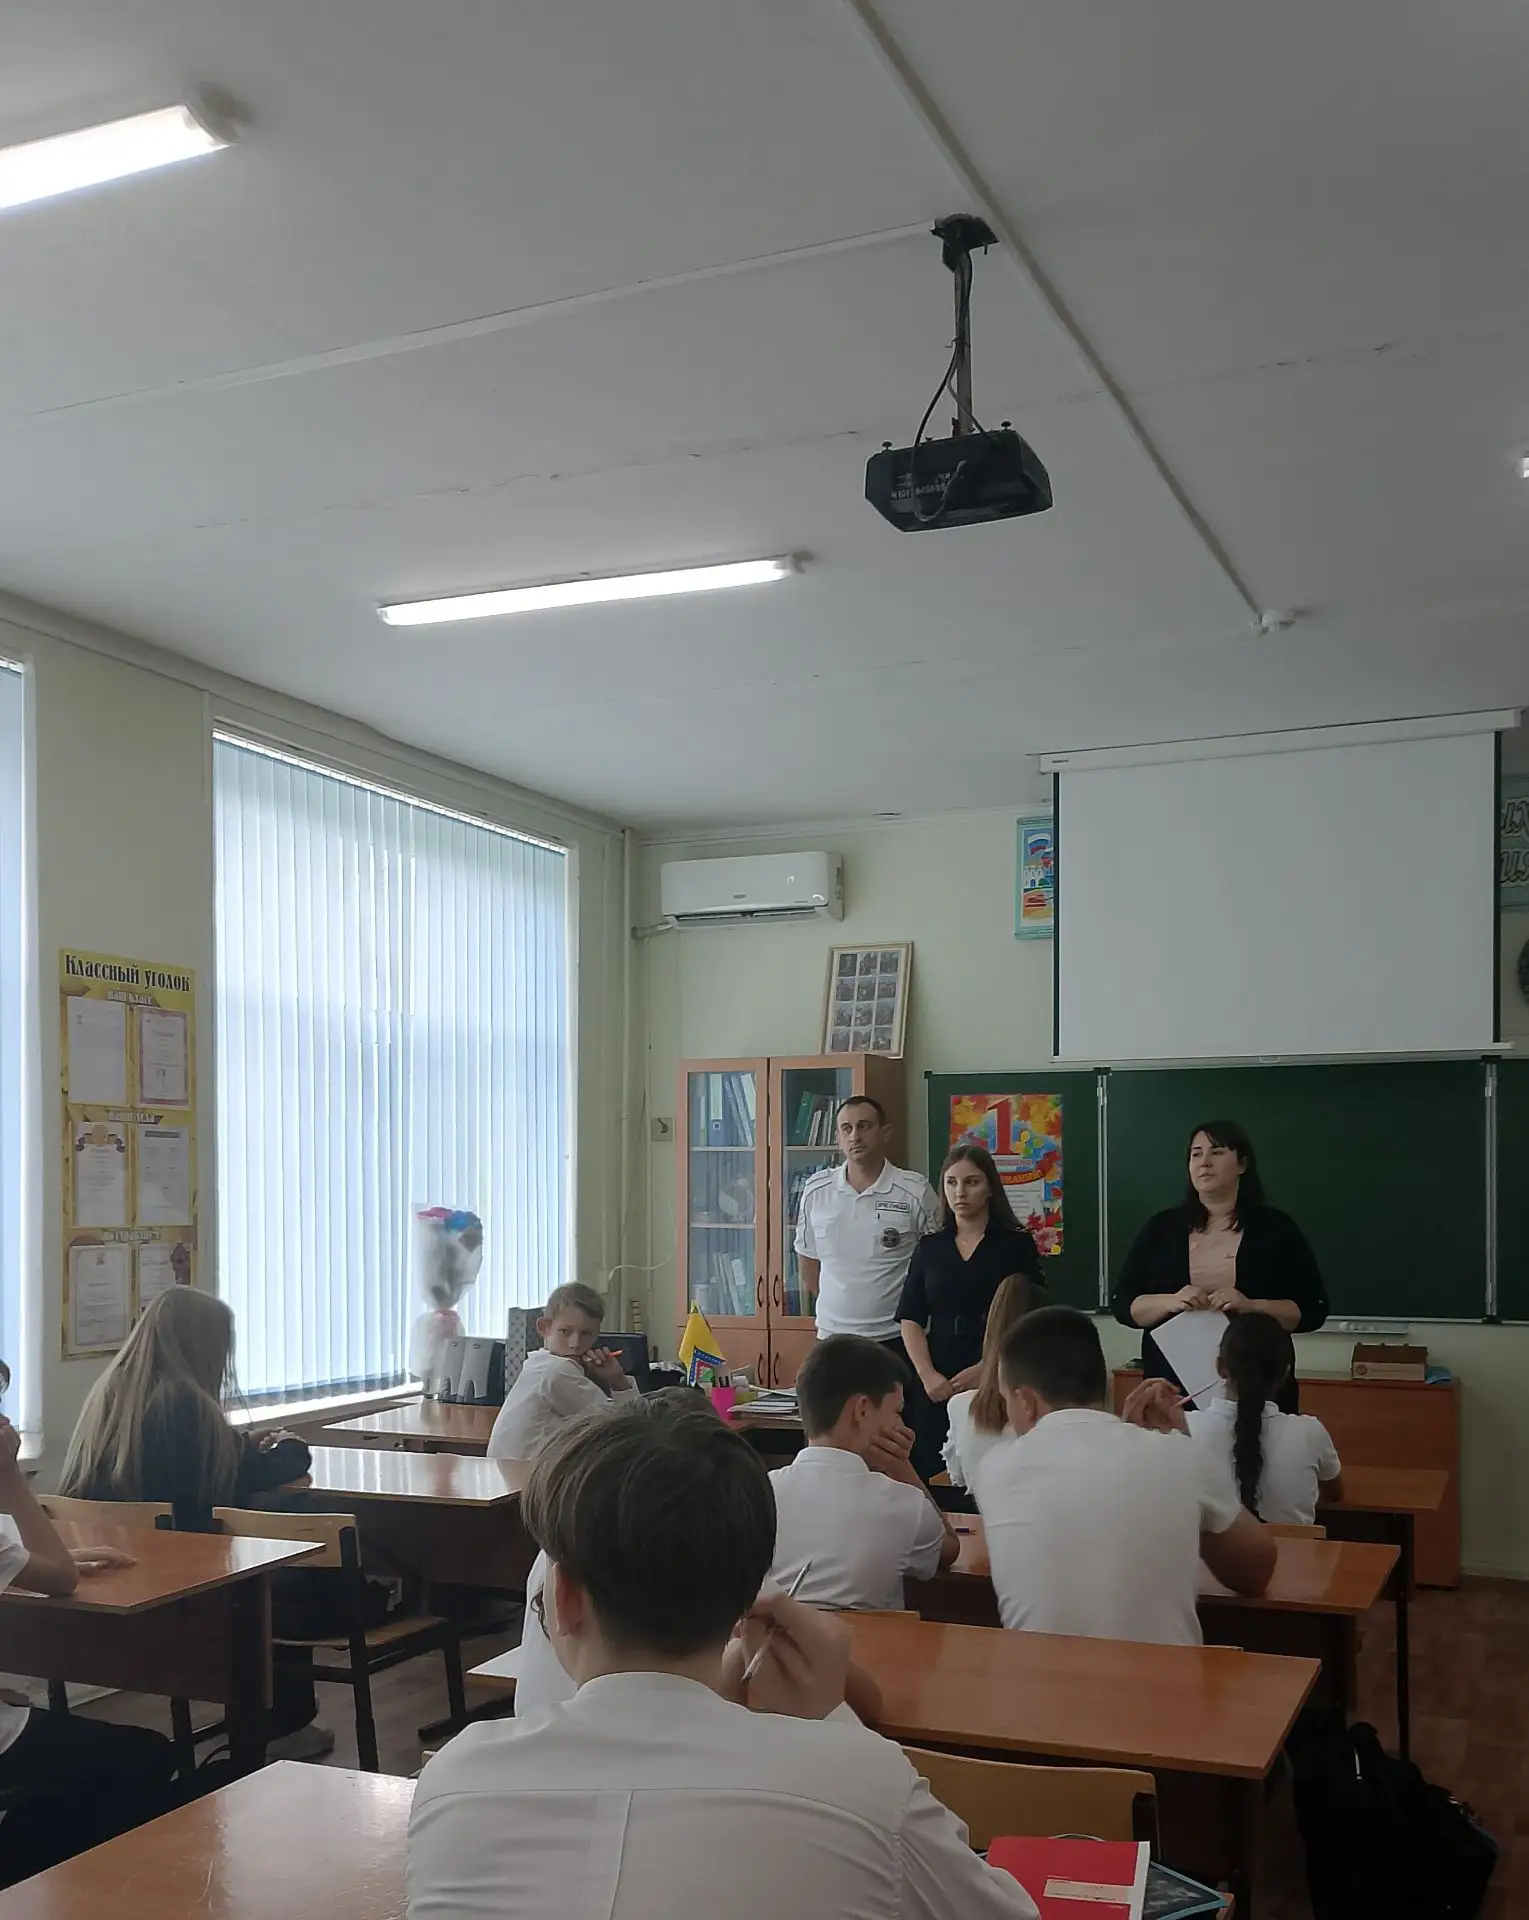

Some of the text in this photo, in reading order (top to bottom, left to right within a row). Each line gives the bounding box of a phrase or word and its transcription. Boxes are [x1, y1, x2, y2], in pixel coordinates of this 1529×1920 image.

[65, 954, 191, 992] Классный уголок
[986, 1097, 1020, 1155] 1
